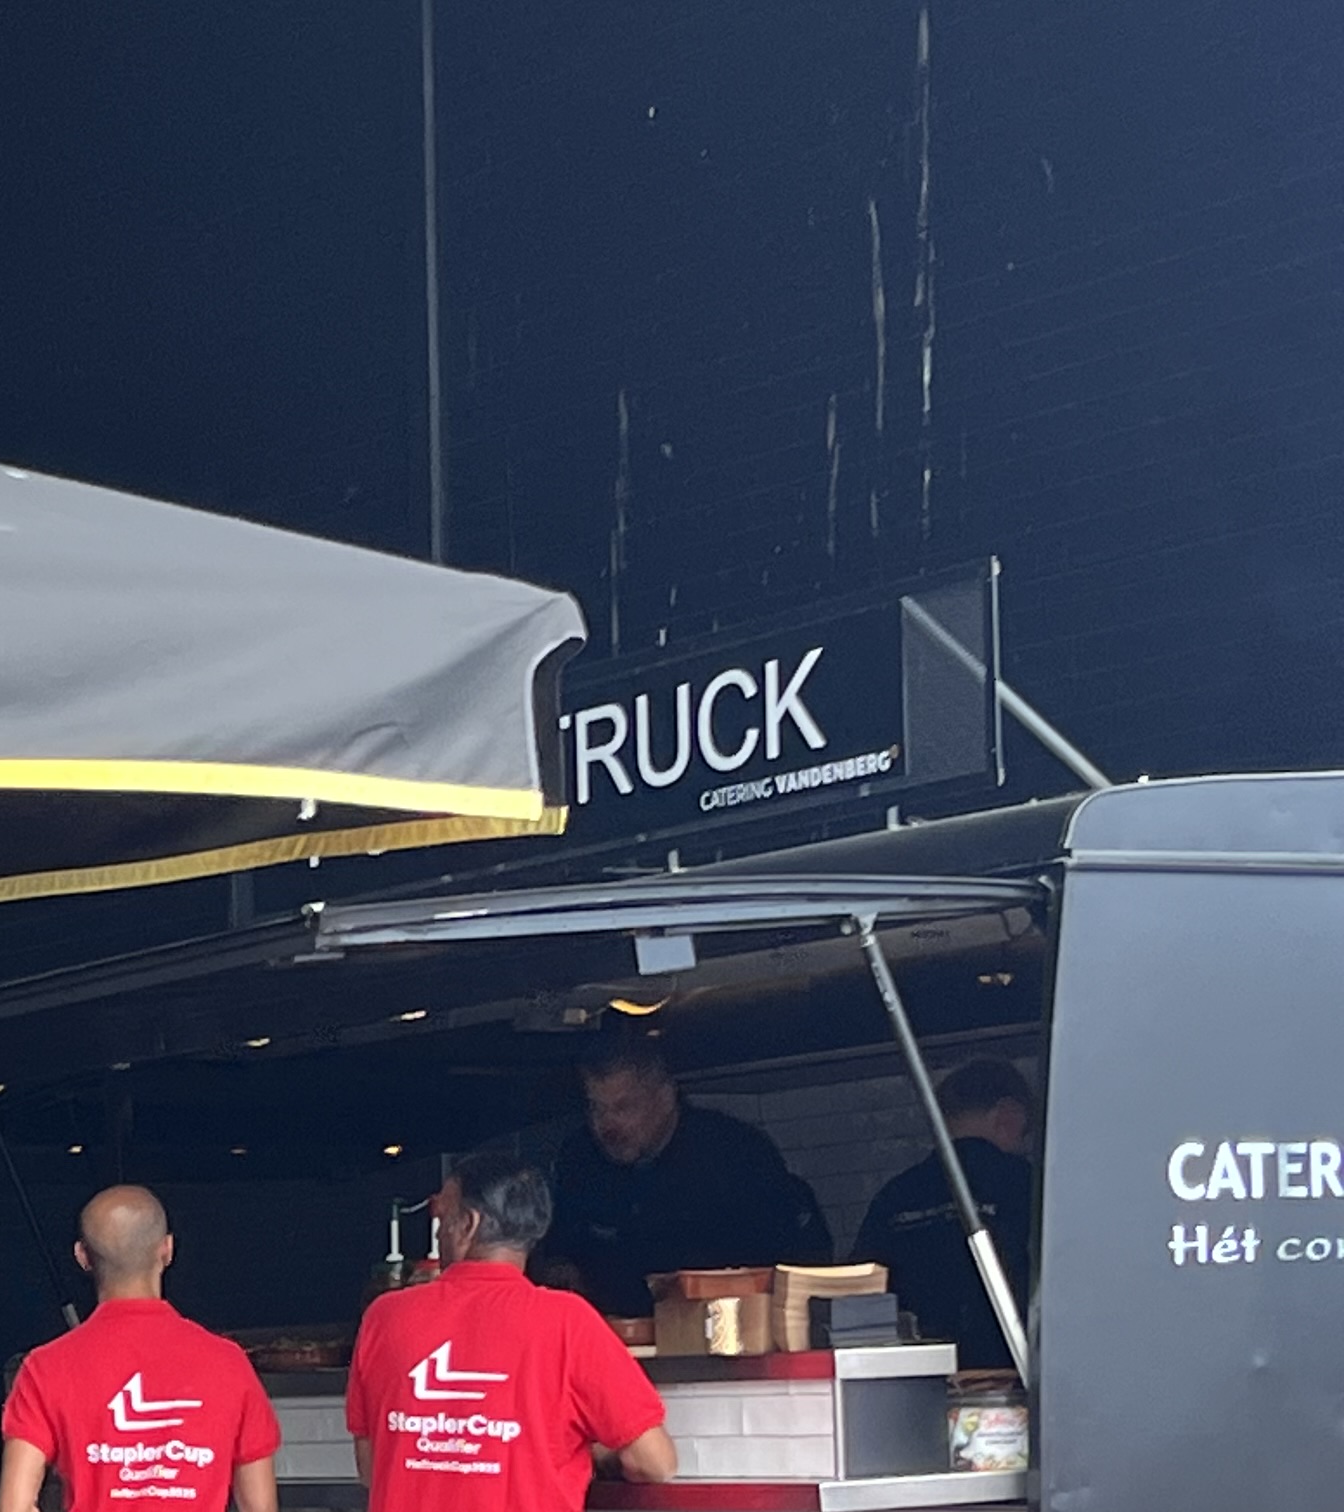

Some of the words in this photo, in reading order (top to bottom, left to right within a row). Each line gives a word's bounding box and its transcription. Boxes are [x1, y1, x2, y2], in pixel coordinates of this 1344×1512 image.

[559, 646, 828, 805] RUCK
[700, 777, 774, 811] CATERING
[775, 750, 892, 795] VANDENBERG
[1167, 1140, 1344, 1202] CATER
[1167, 1223, 1262, 1266] Hét
[387, 1410, 522, 1443] StaplerCup
[86, 1439, 215, 1468] StaplerCup
